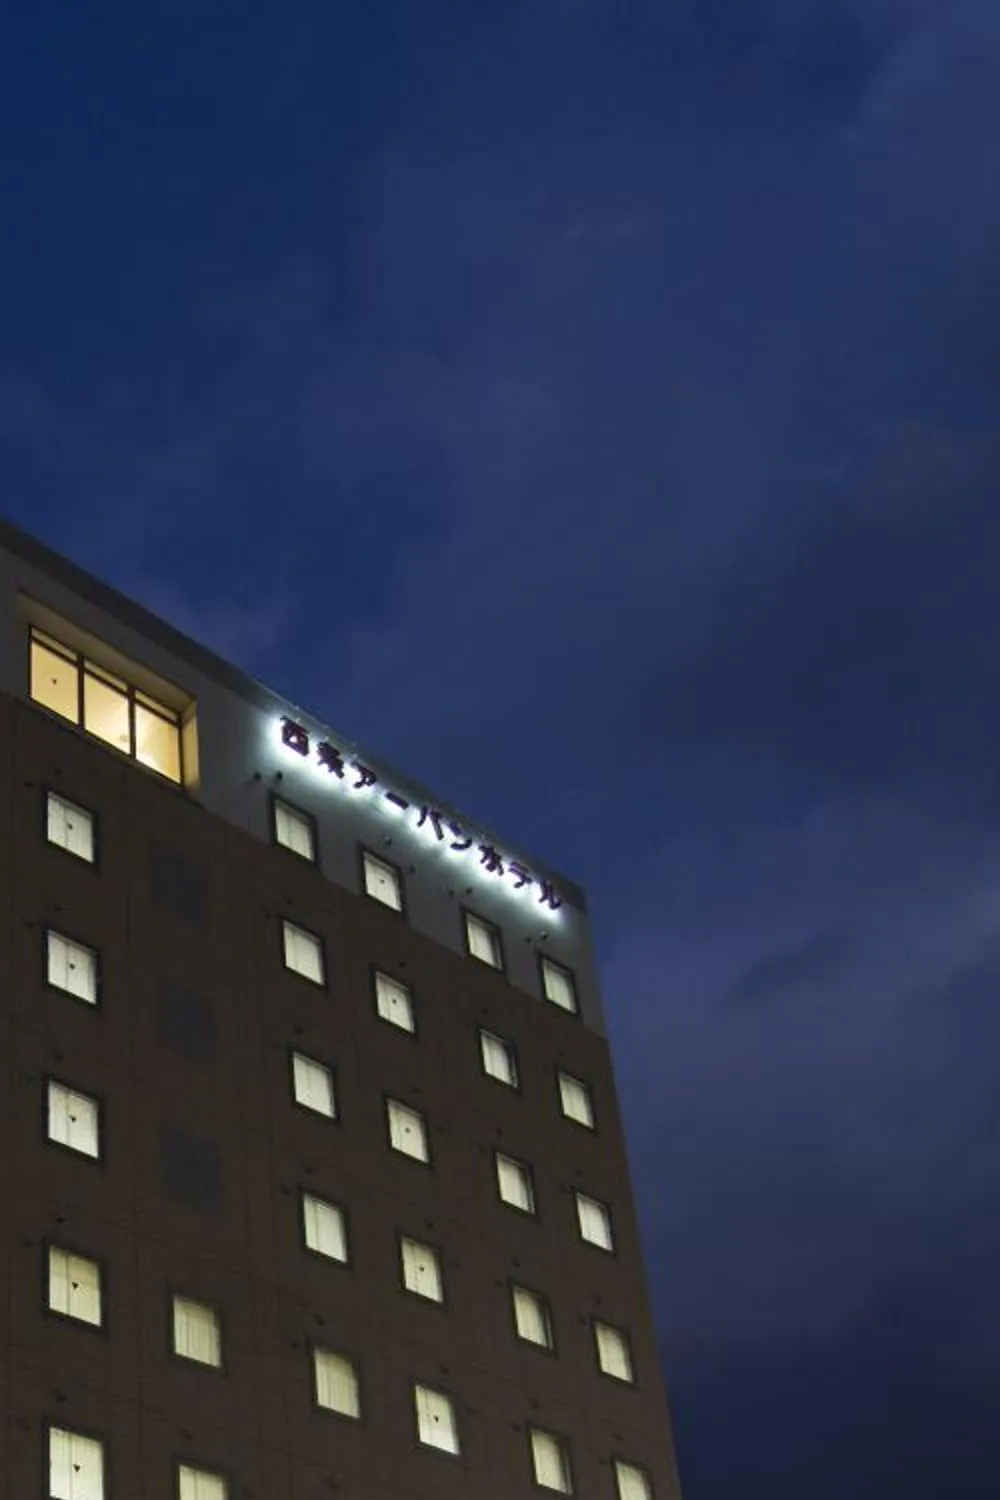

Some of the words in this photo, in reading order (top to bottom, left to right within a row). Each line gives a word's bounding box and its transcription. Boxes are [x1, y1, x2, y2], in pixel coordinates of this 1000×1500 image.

[280, 714, 562, 911] 西条アーバンホテル
